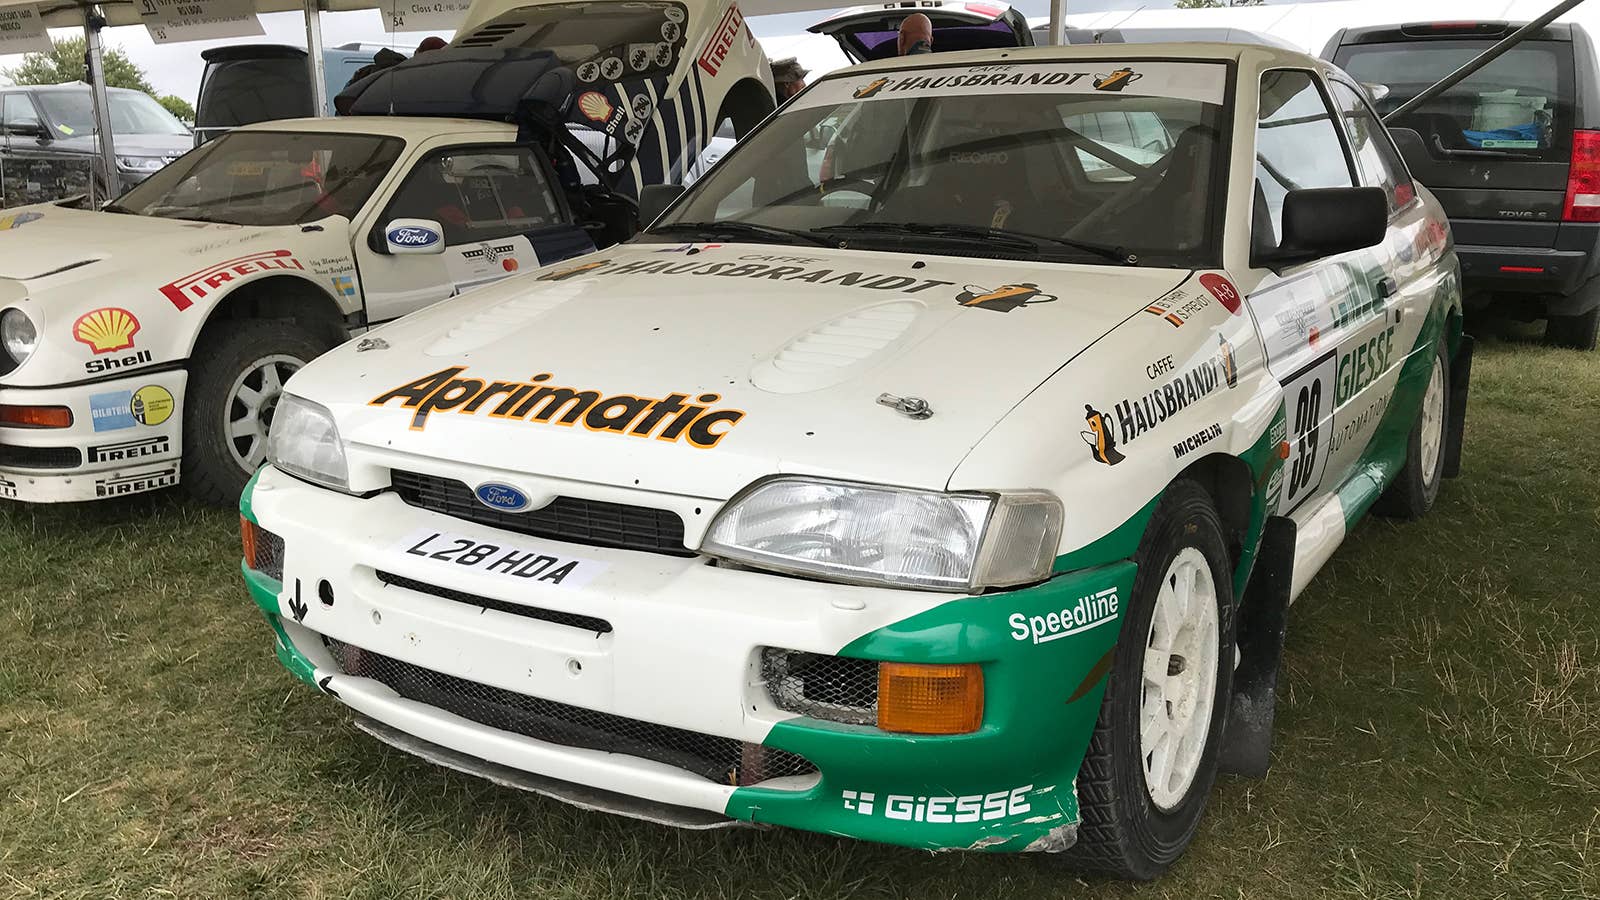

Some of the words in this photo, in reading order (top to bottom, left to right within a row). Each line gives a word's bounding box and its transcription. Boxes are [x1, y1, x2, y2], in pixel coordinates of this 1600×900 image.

[698, 2, 743, 77] PIRELLI
[889, 72, 1090, 92] HAUSBRANDT
[606, 105, 625, 135] Shell
[395, 228, 428, 244] Ford
[159, 250, 305, 312] PIRELLI
[598, 259, 955, 293] HAUSBRANDT
[85, 350, 152, 373] Shell
[1336, 327, 1394, 407] GIESSE
[368, 365, 748, 449] Aprimatic
[1115, 357, 1218, 445] HAUSBRANDT
[87, 435, 169, 463] PIRELLI
[1173, 423, 1222, 459] MICHELIN
[1288, 378, 1321, 500] 39
[95, 468, 176, 497] PIRELLI
[485, 487, 515, 506] Ford
[406, 533, 500, 566] L28
[490, 548, 580, 584] HDA
[1009, 590, 1119, 644] Speedline
